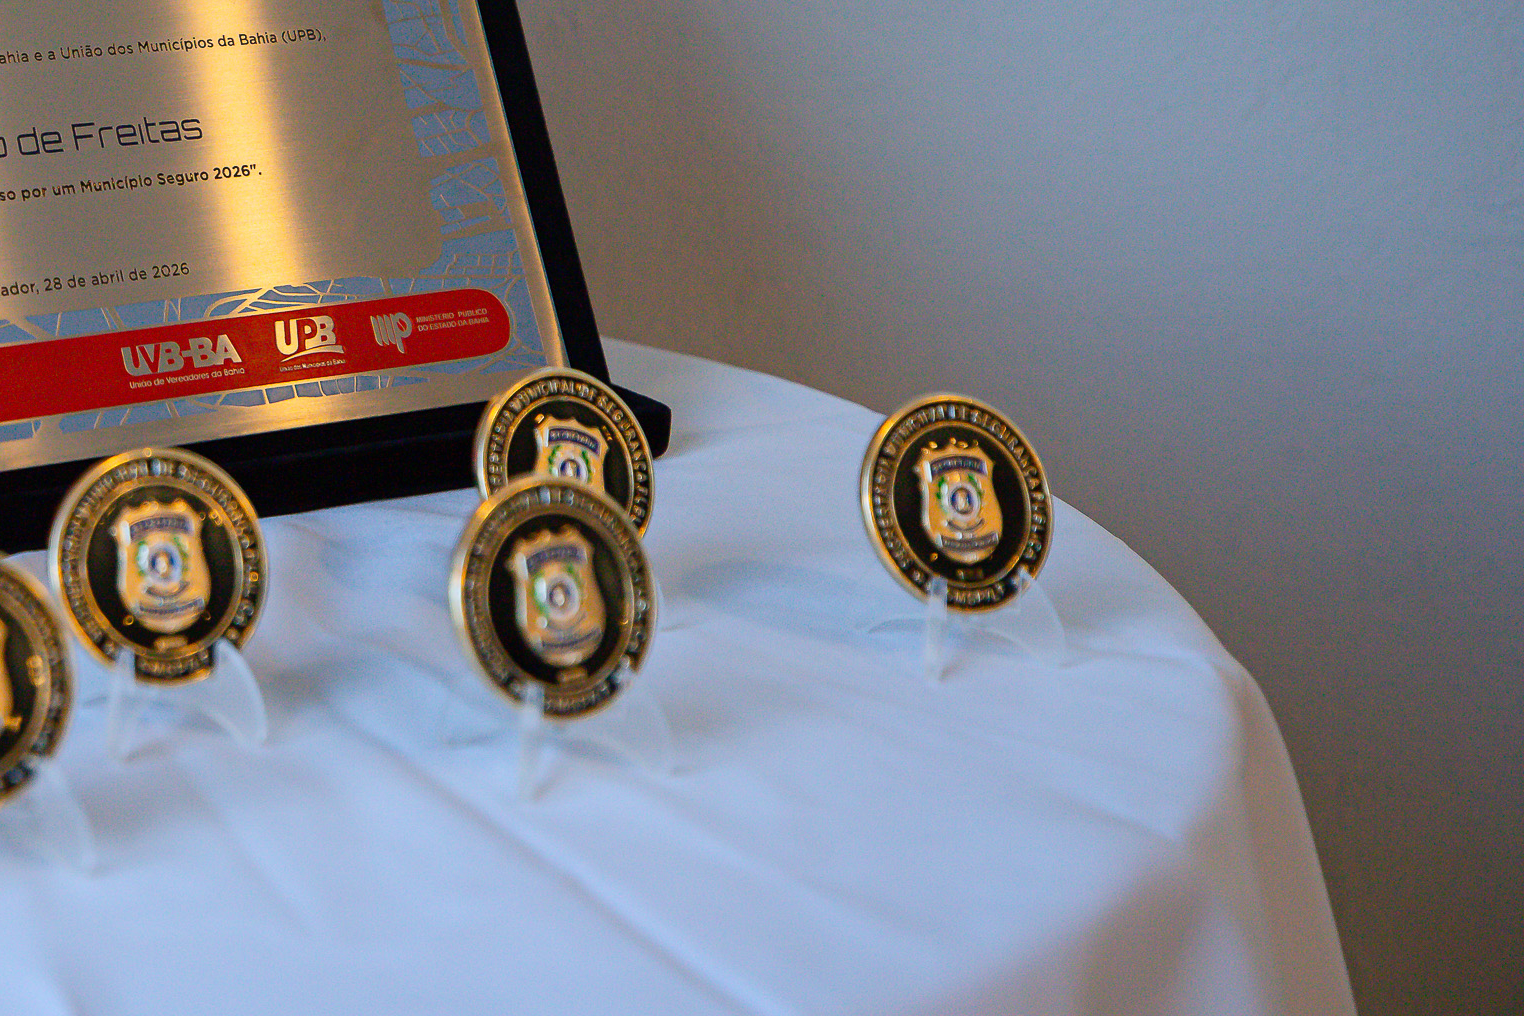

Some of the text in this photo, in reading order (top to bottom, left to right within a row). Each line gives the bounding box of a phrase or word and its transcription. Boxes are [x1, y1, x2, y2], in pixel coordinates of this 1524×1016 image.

[33, 51, 44, 62] e
[47, 50, 56, 61] a
[59, 43, 103, 60] União
[107, 41, 134, 56] dos
[137, 36, 214, 55] Municípios
[217, 33, 235, 47] da
[238, 30, 277, 46] Bahia
[281, 27, 327, 44] (UPB),
[16, 126, 65, 156] de
[71, 116, 204, 151] Freitas
[21, 185, 48, 203] por
[52, 183, 76, 197] um
[80, 174, 153, 196] Município
[157, 169, 209, 189] Seguro
[43, 277, 63, 292] 28
[66, 273, 87, 290] de
[90, 267, 125, 287] abril
[128, 266, 148, 282] de
[152, 262, 190, 280] 2026
[274, 315, 337, 356] UPB
[417, 317, 490, 332] DO ESTADO DA BAHIA
[120, 334, 243, 377] UVB-BA
[129, 366, 245, 389] União de Vereadores da Bahia
